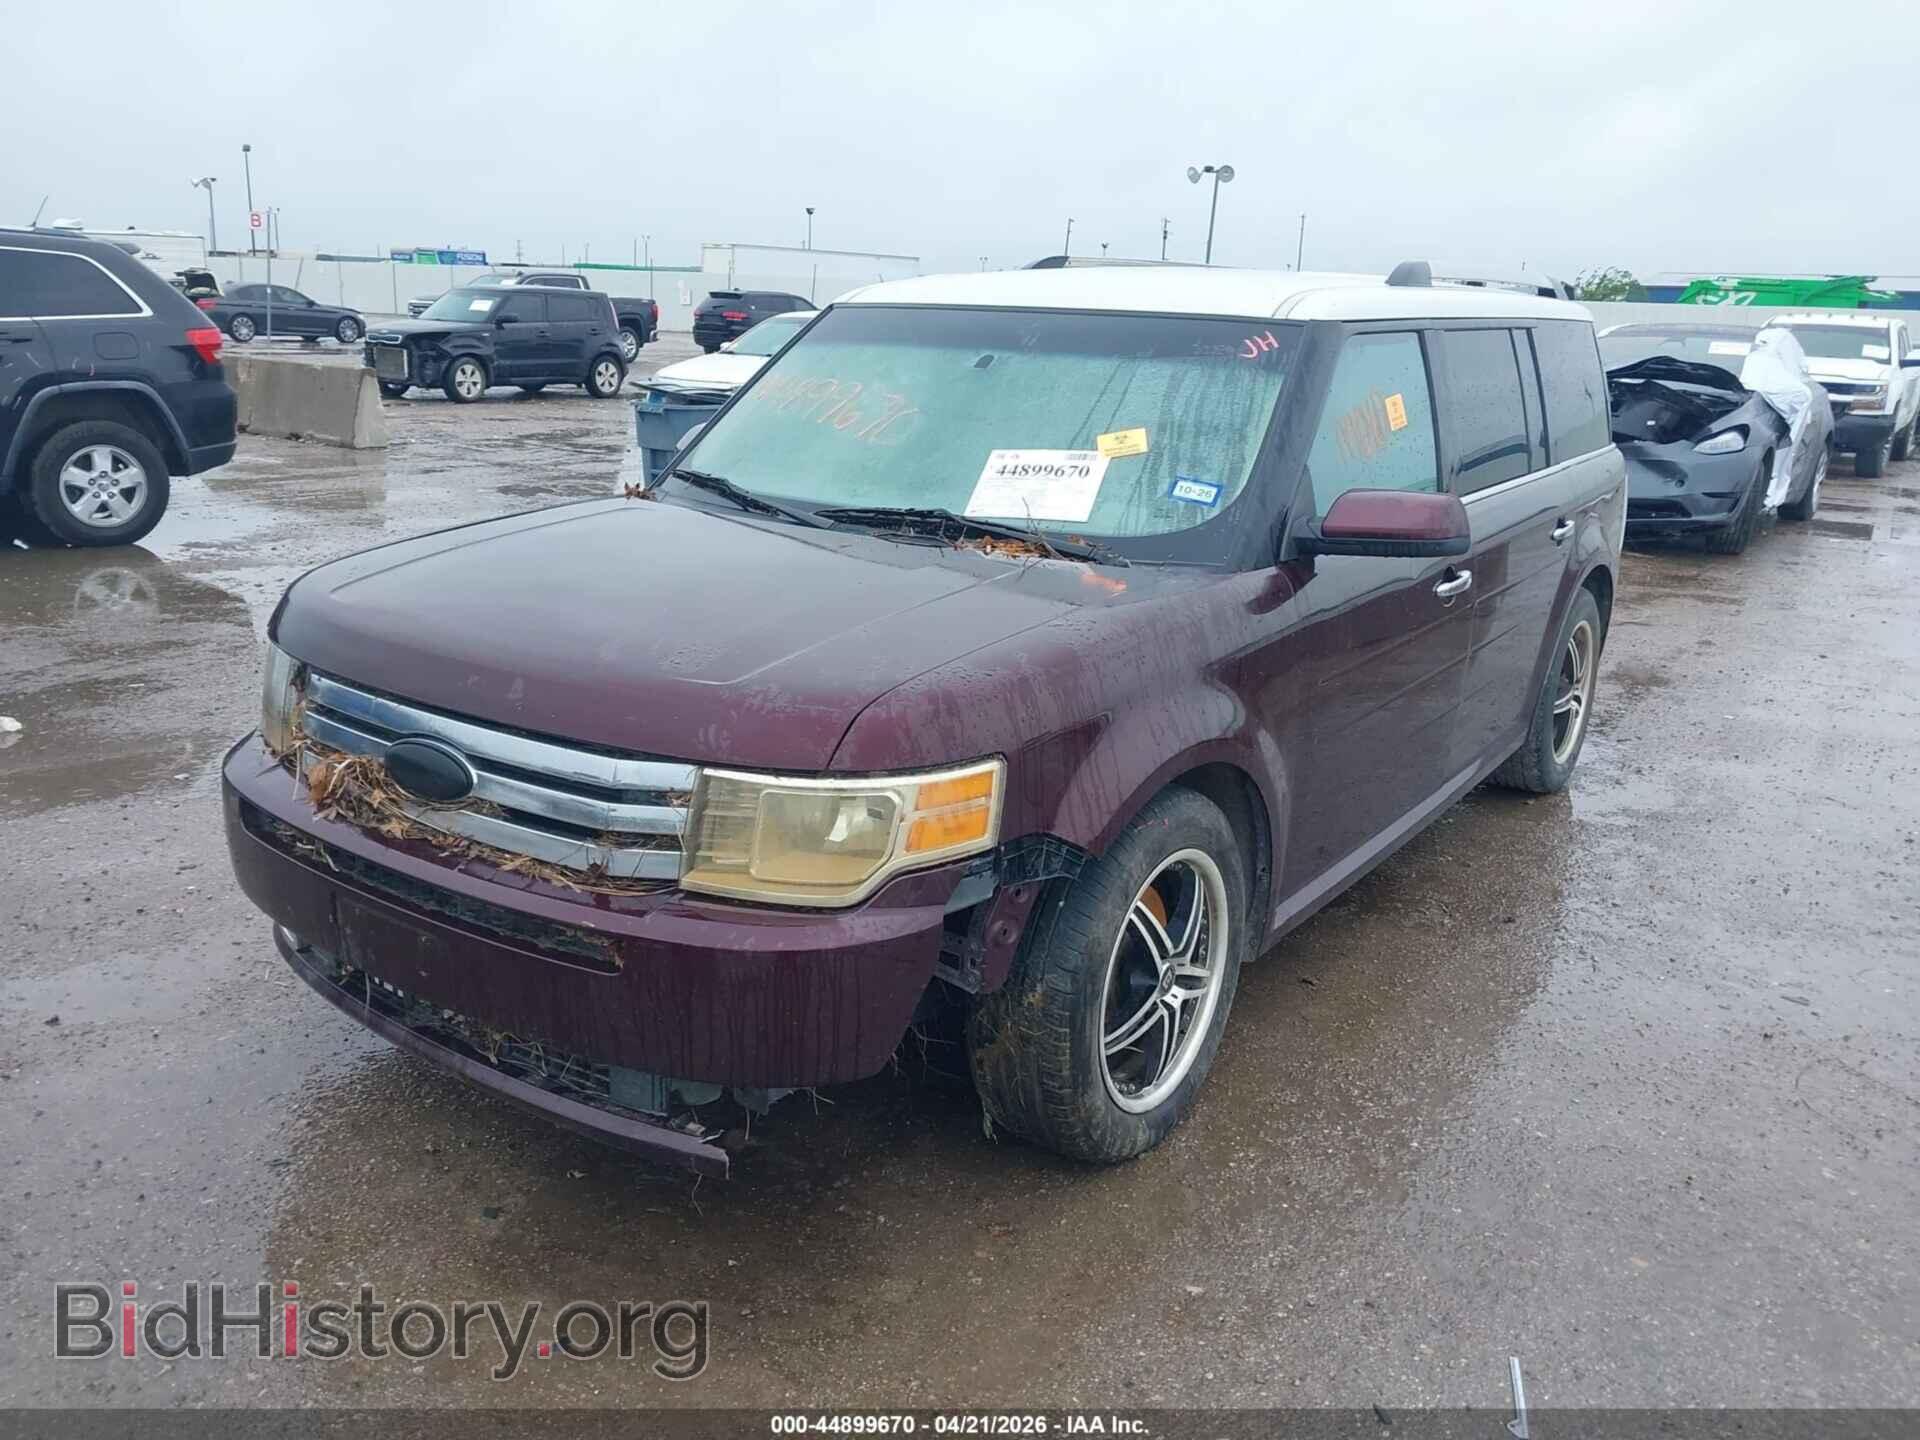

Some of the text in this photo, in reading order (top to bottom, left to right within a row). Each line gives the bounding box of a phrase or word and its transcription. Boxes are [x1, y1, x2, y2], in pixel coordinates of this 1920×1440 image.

[250, 213, 262, 228] B
[1239, 330, 1279, 358] JH
[995, 463, 1091, 478] 44899670
[1177, 484, 1213, 499] 10-26
